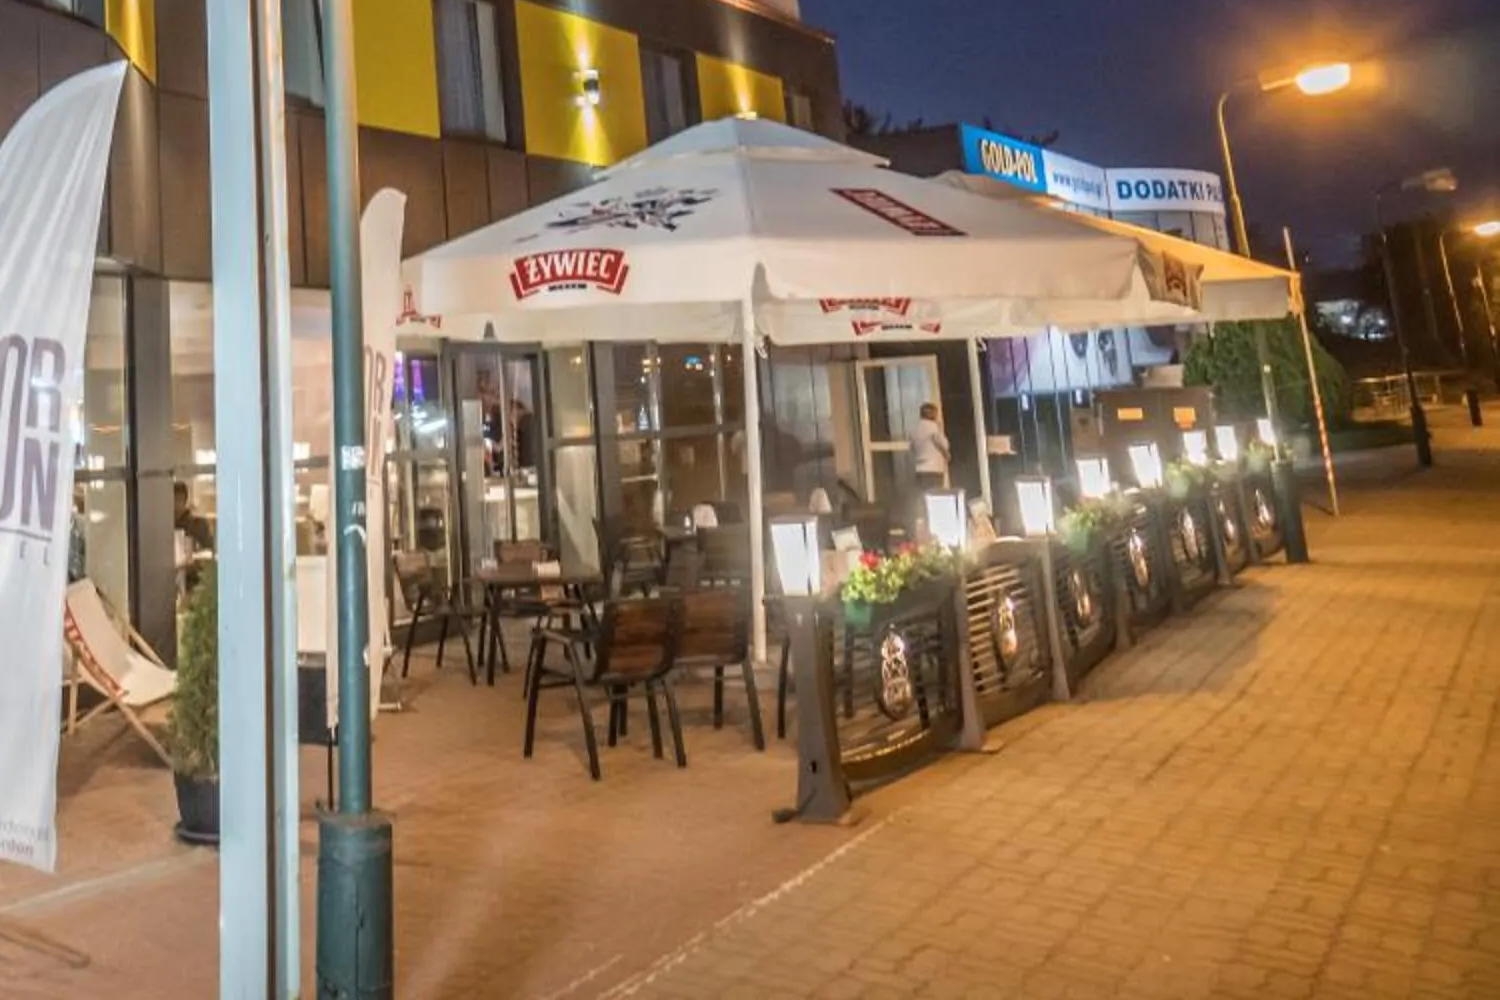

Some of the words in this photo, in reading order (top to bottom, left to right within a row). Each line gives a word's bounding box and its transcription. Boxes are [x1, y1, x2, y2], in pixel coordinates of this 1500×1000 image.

[980, 138, 1039, 183] GOLD-POL
[1117, 179, 1205, 201] DODATKI
[523, 251, 616, 285] ŻYWIEC
